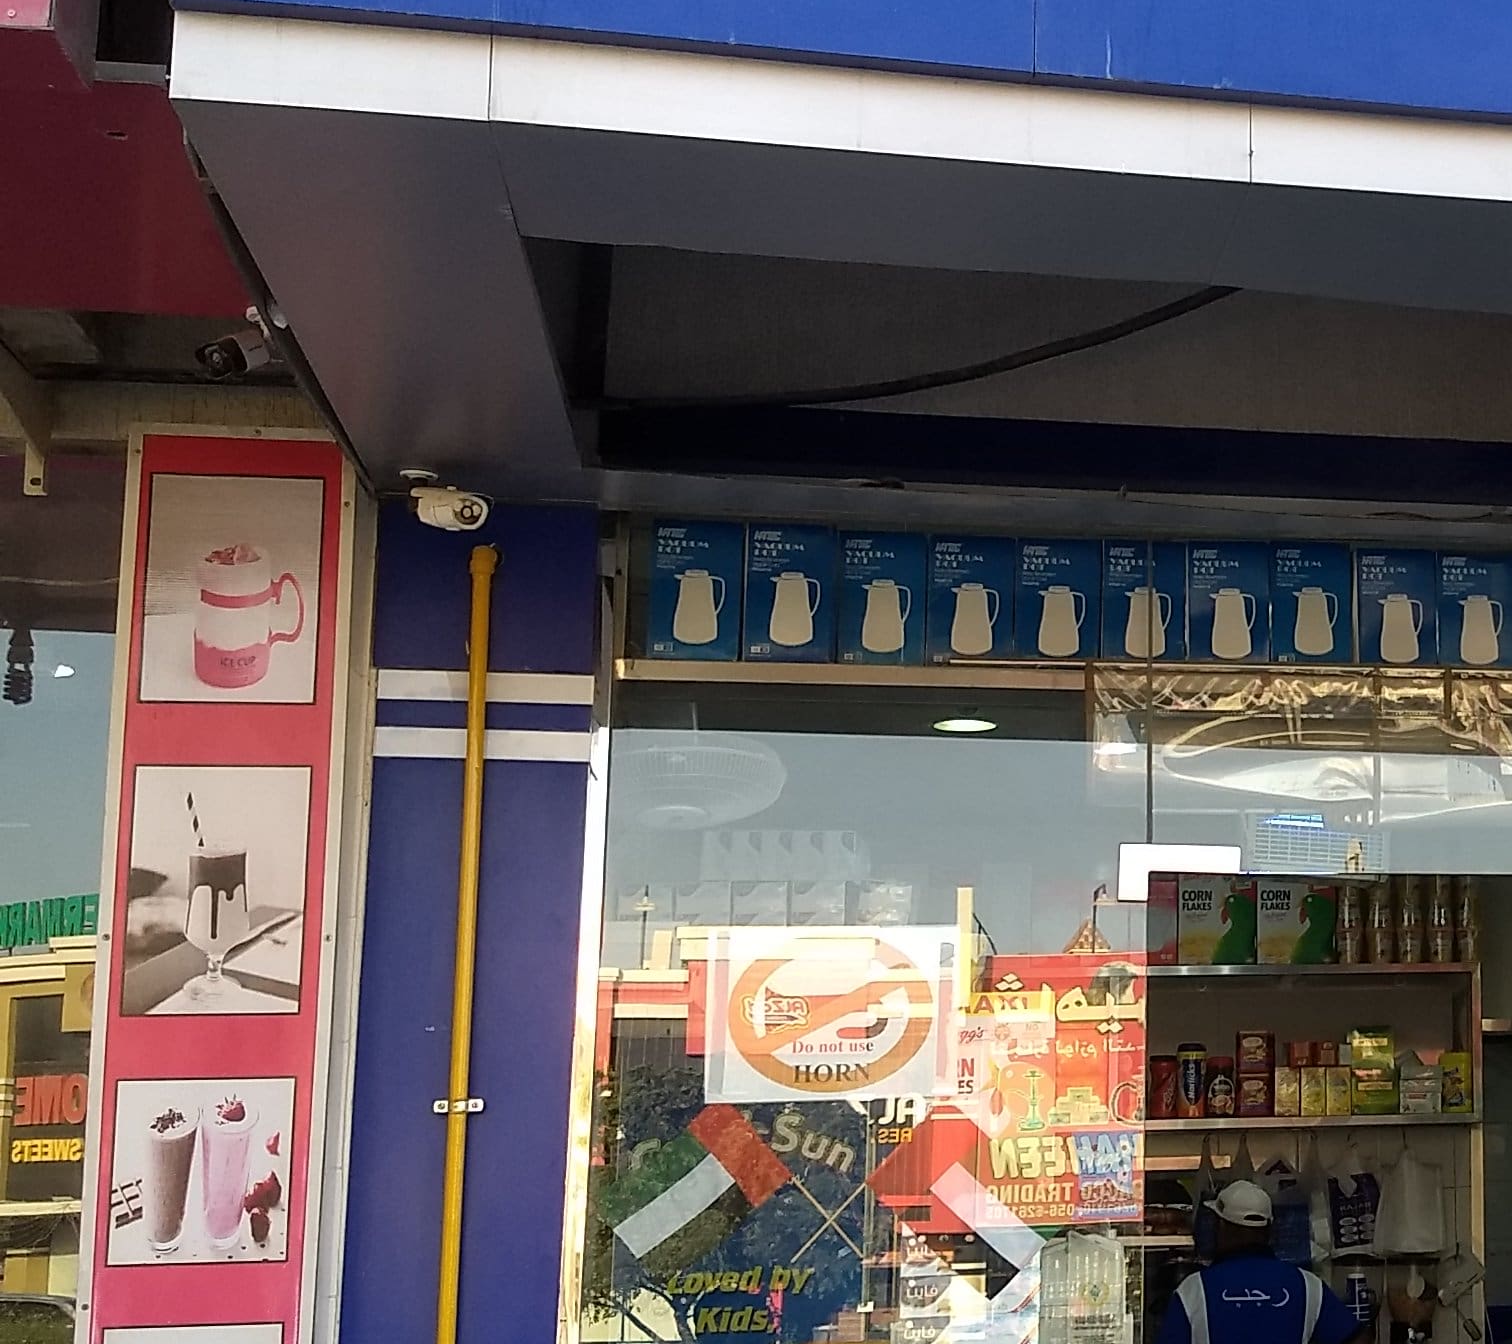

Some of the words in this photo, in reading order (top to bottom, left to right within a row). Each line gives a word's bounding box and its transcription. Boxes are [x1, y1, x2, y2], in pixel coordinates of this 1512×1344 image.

[1182, 890, 1213, 902] CORN
[1260, 890, 1291, 902] CORN
[1182, 902, 1212, 911] FLAKES
[1260, 902, 1291, 911] FLAKES
[792, 1040, 814, 1054] Do
[819, 1039, 843, 1053] not
[849, 1040, 874, 1052] use
[793, 1063, 871, 1084] HORN
[667, 1265, 763, 1295] Loved
[770, 1264, 815, 1295] by
[1222, 1287, 1290, 1308] رجب
